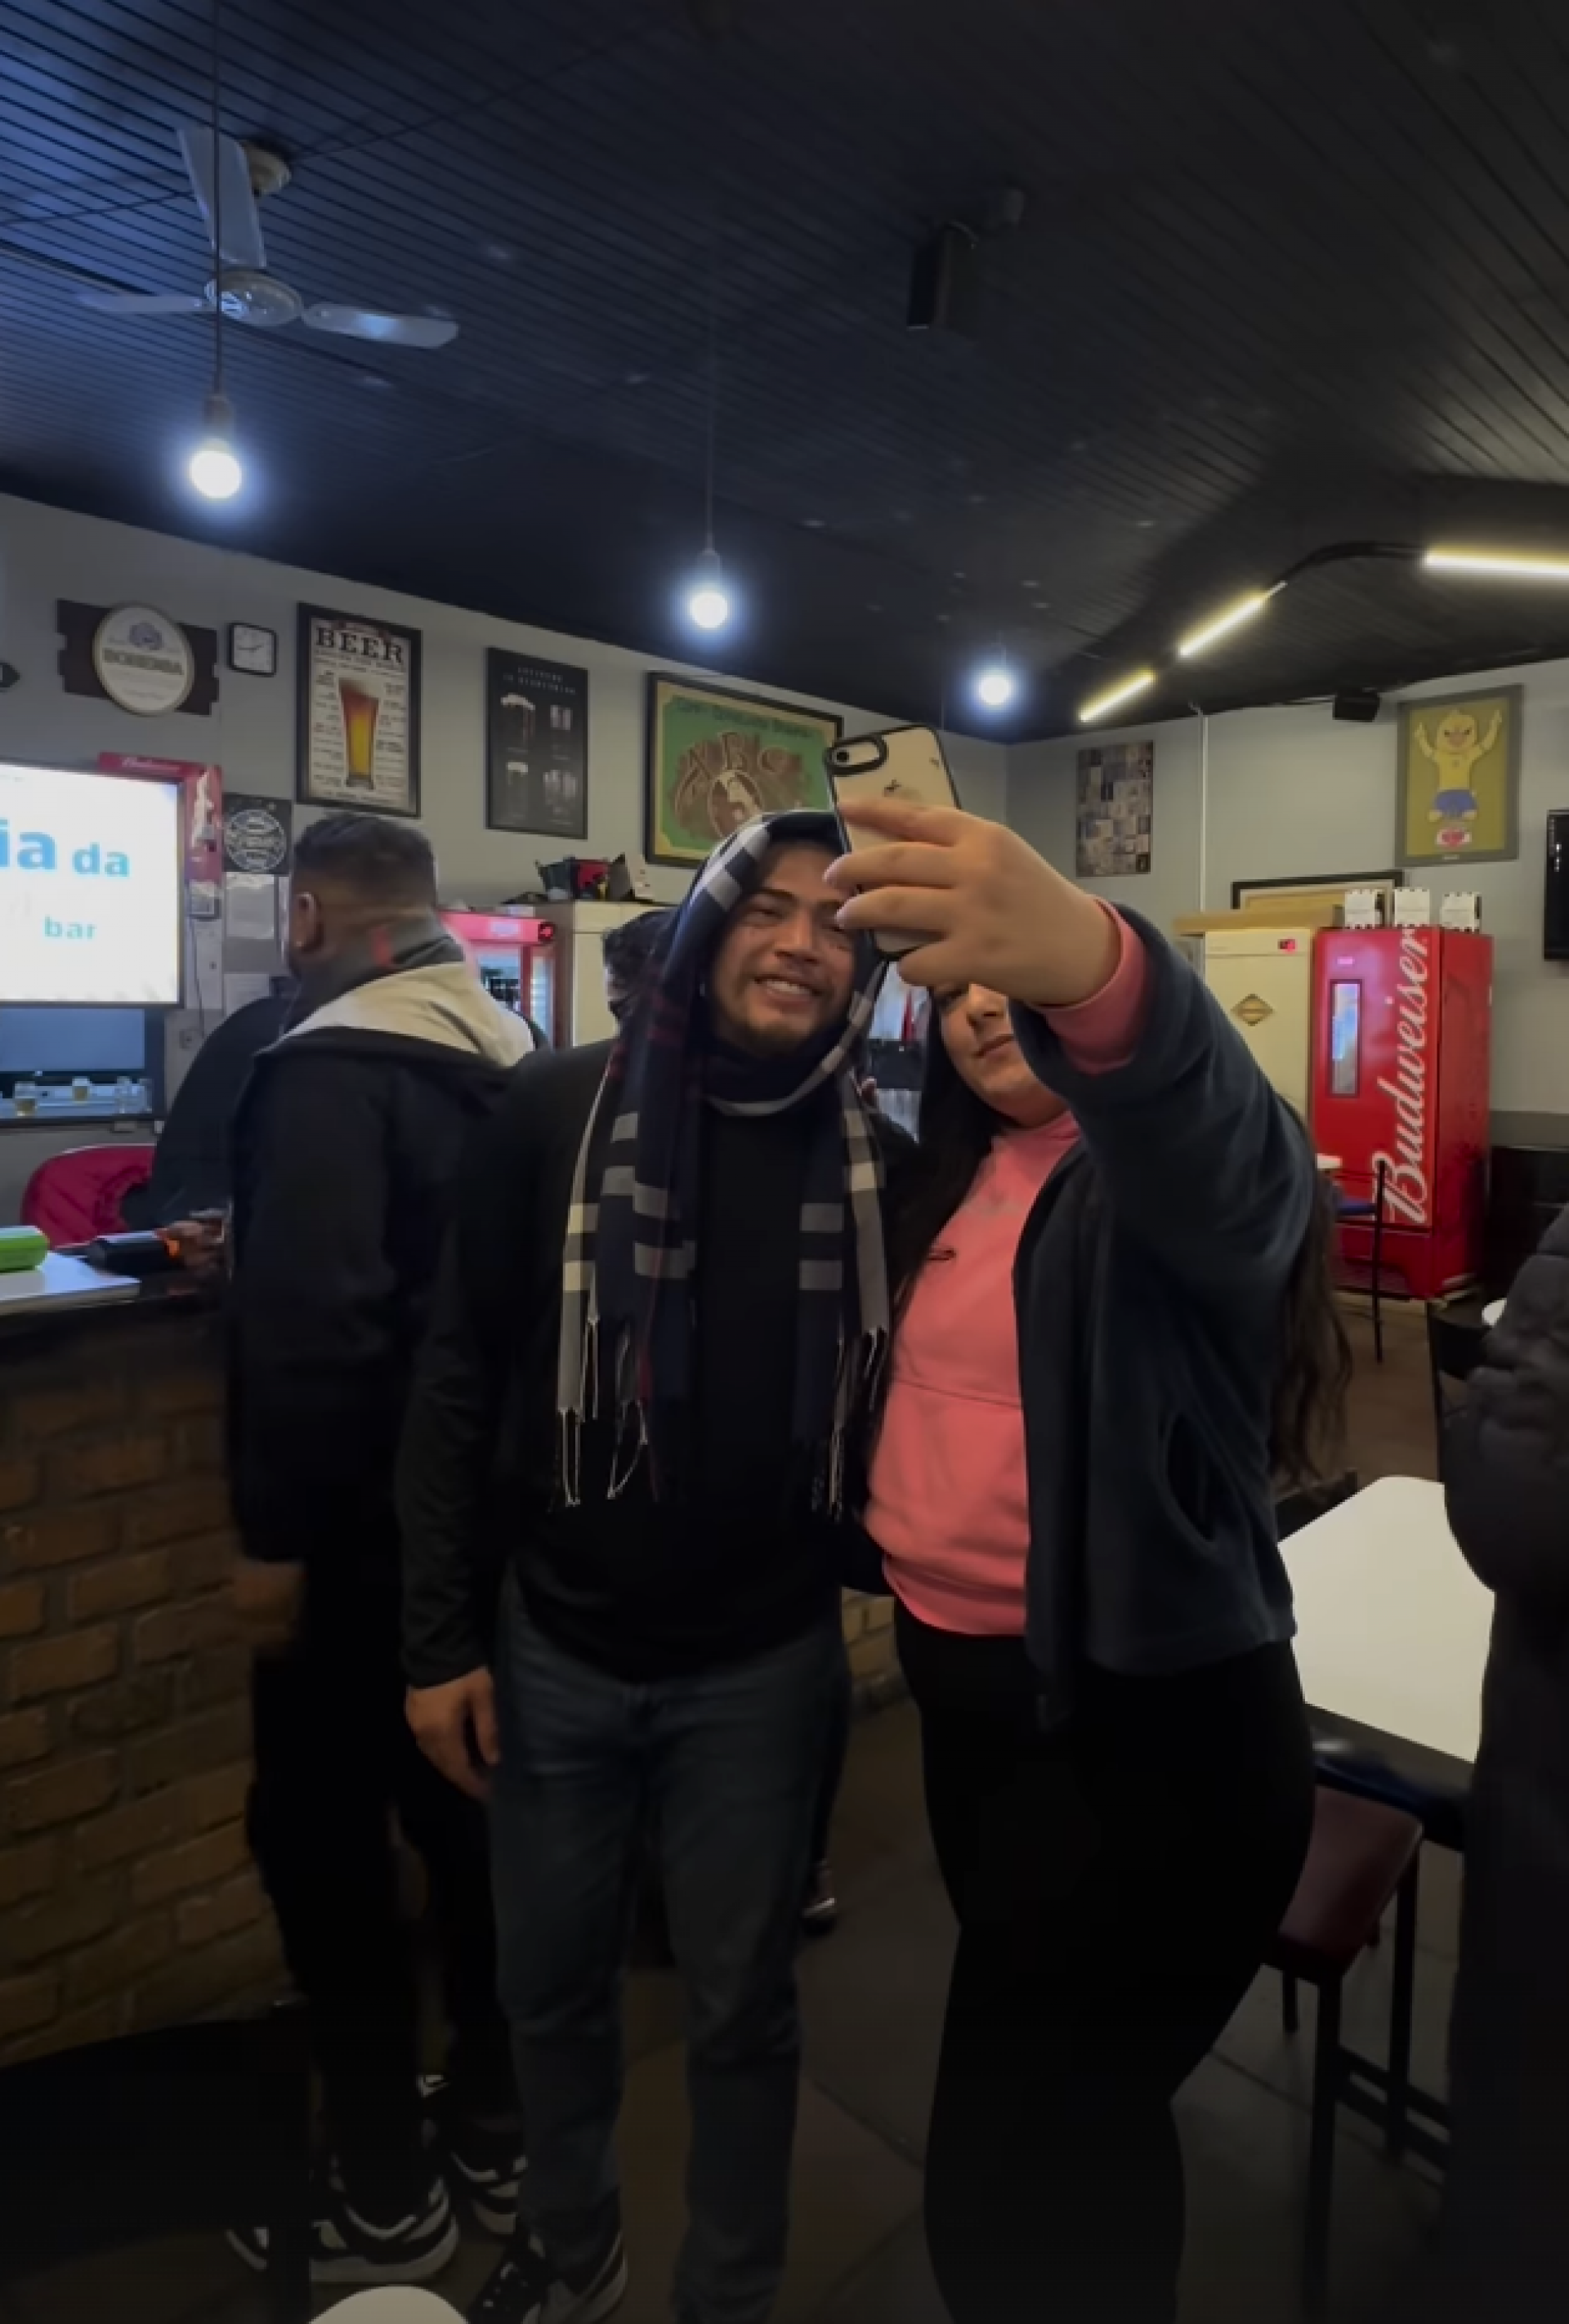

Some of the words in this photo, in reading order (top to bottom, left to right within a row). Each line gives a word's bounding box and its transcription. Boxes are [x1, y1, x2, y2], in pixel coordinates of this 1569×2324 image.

[315, 627, 403, 664] BEER
[72, 842, 130, 877] da
[44, 914, 96, 939] bar
[1372, 928, 1429, 1225] Budweiser
